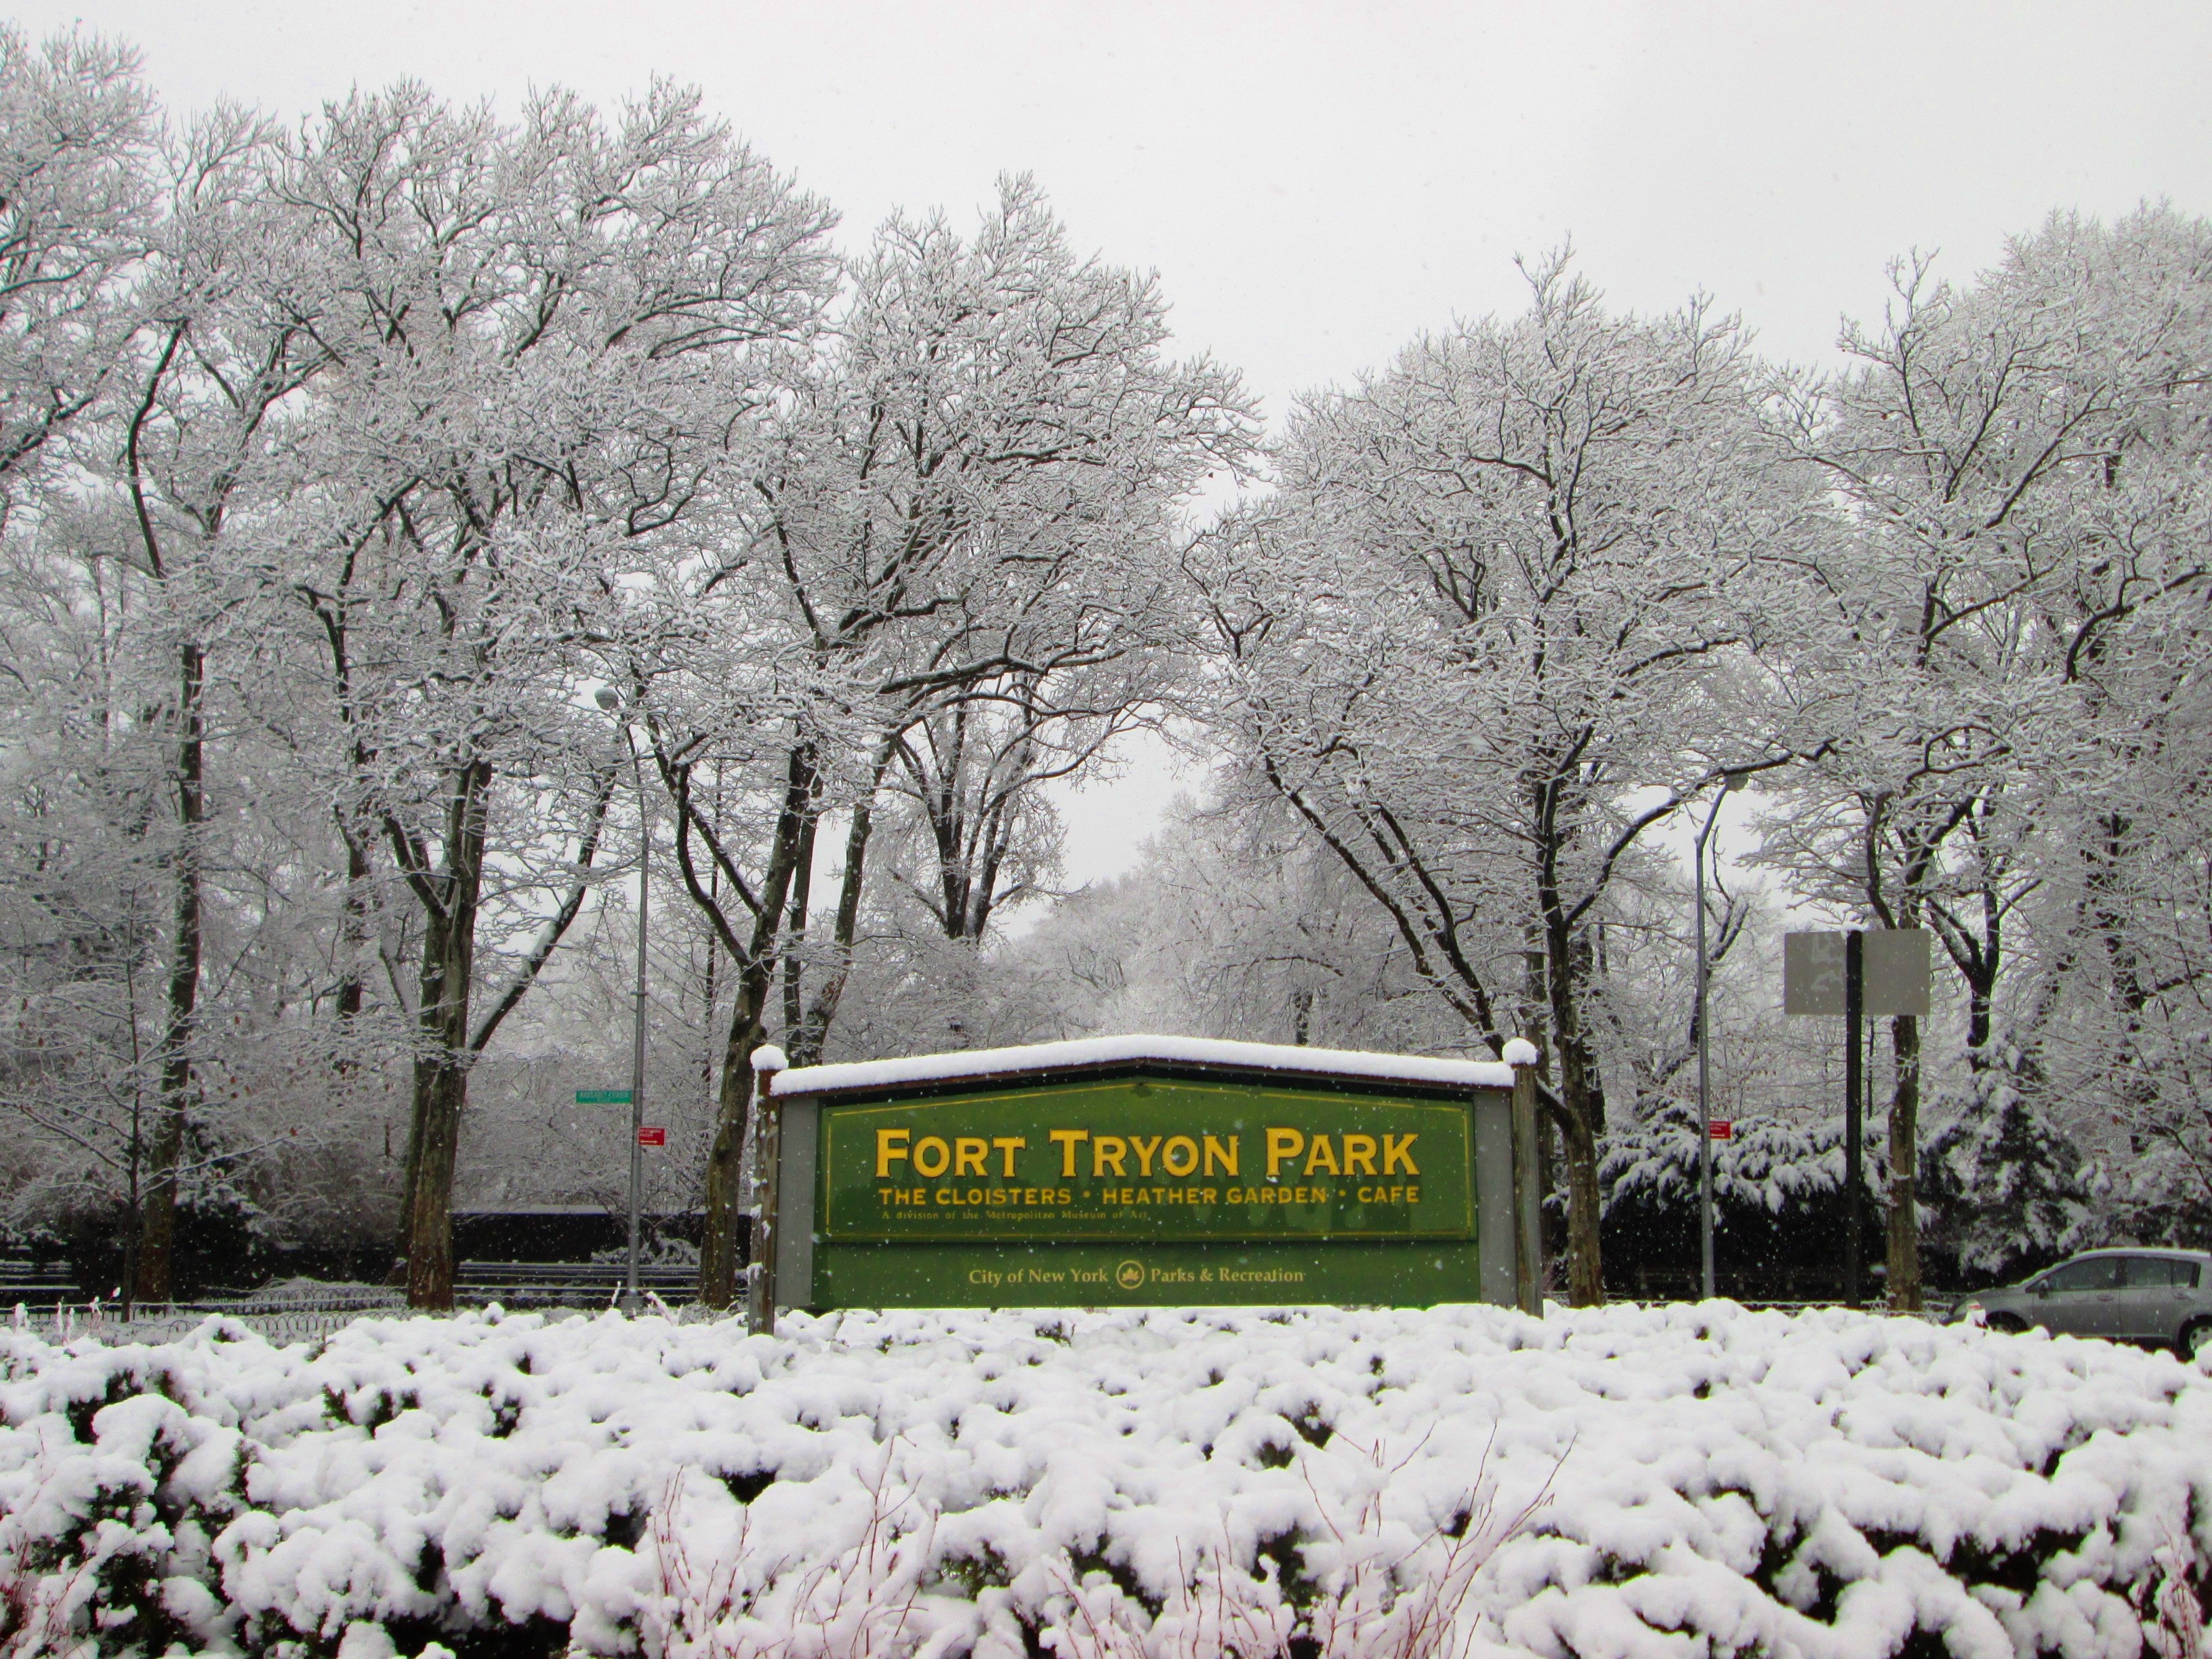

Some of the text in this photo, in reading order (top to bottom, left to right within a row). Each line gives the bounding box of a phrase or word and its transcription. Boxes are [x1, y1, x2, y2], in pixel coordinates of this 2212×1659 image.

[875, 1127, 1420, 1178] FORT TRYON PARK
[878, 1186, 1419, 1205] THE CLOISTERS HEATHER GARDEN CAFE
[882, 1209, 1147, 1222] A division of the Metropolitan Museum of Art
[969, 1267, 1108, 1287] City of New York
[1151, 1268, 1305, 1283] Parks & Recreation
